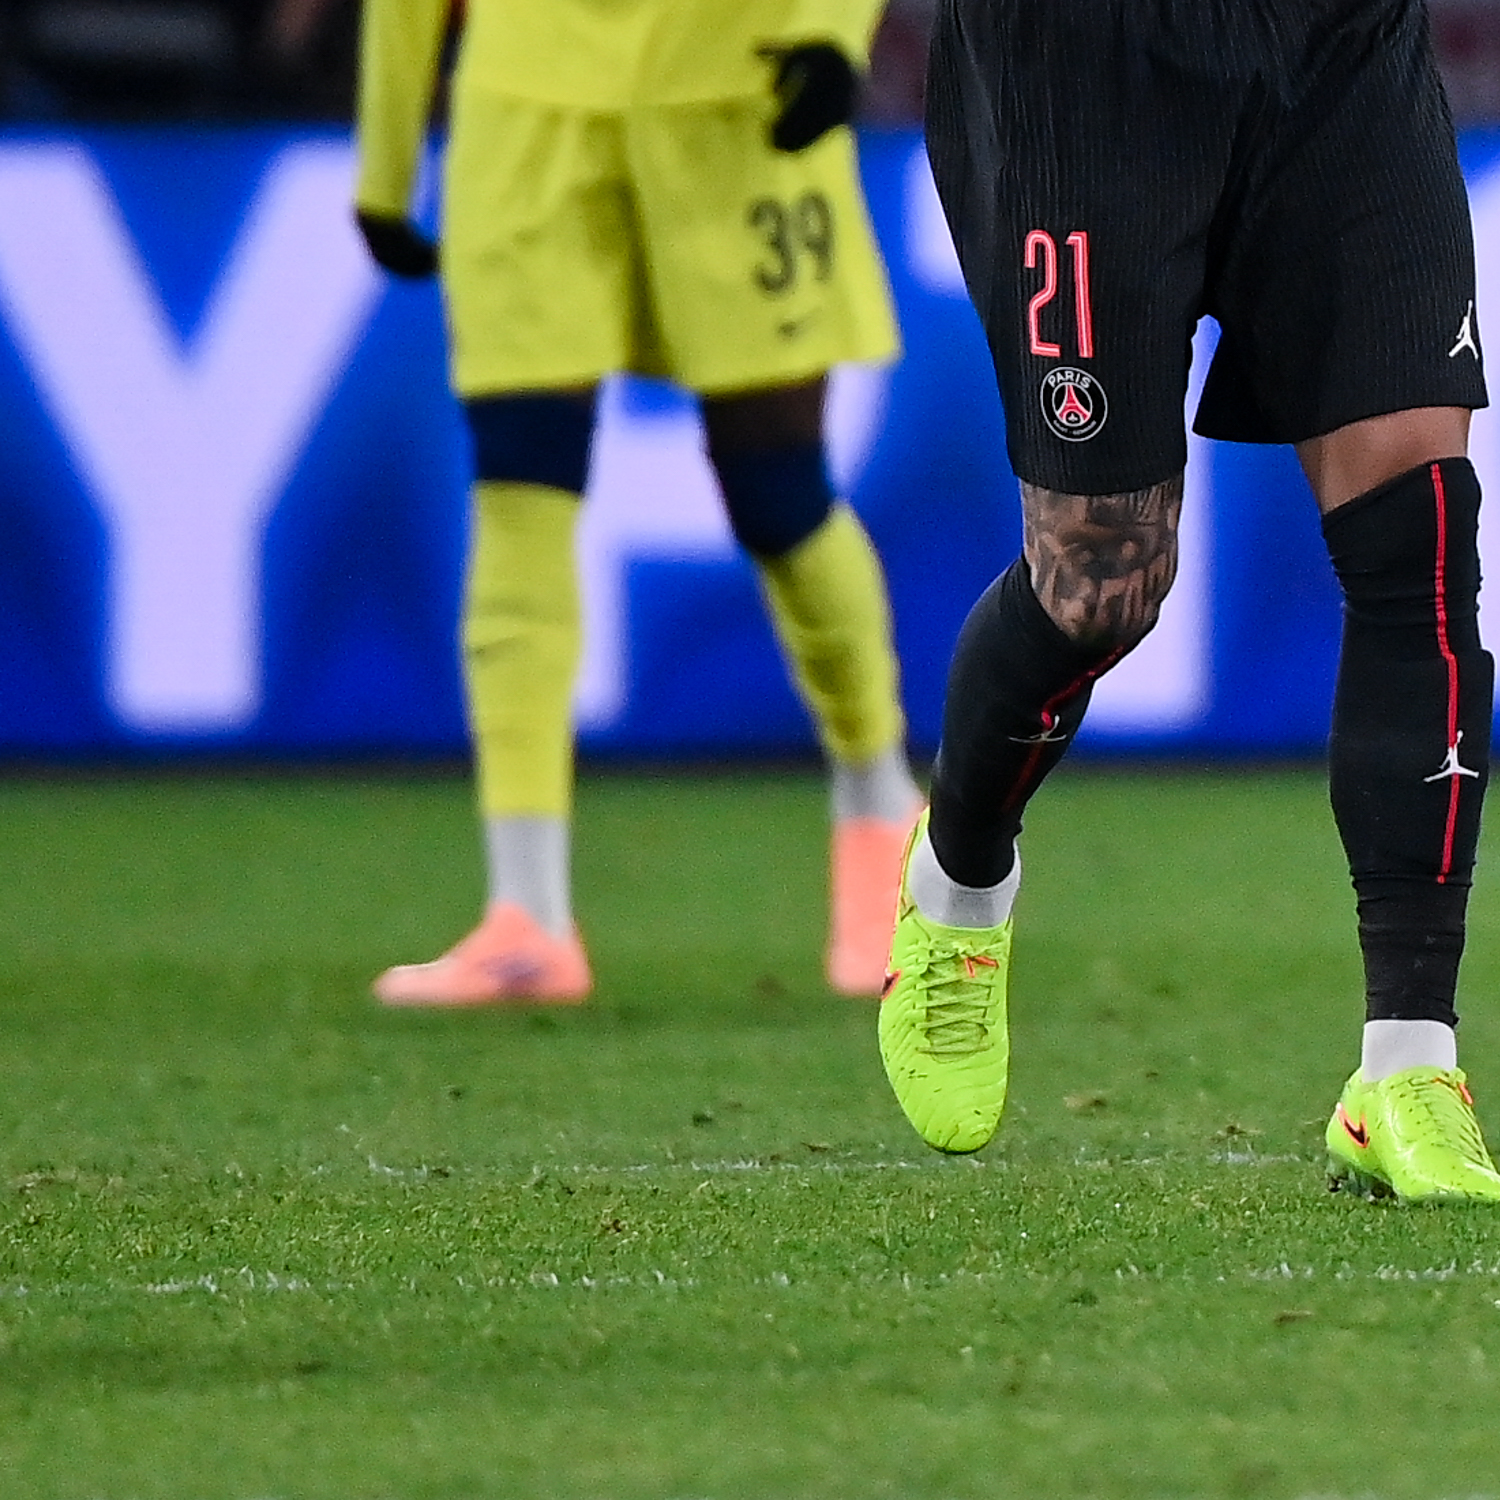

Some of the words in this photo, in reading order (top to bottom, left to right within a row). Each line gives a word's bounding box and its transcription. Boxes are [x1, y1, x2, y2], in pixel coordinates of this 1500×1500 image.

[748, 190, 834, 296] 39
[1024, 228, 1095, 358] 21
[1047, 370, 1091, 388] PARIS
